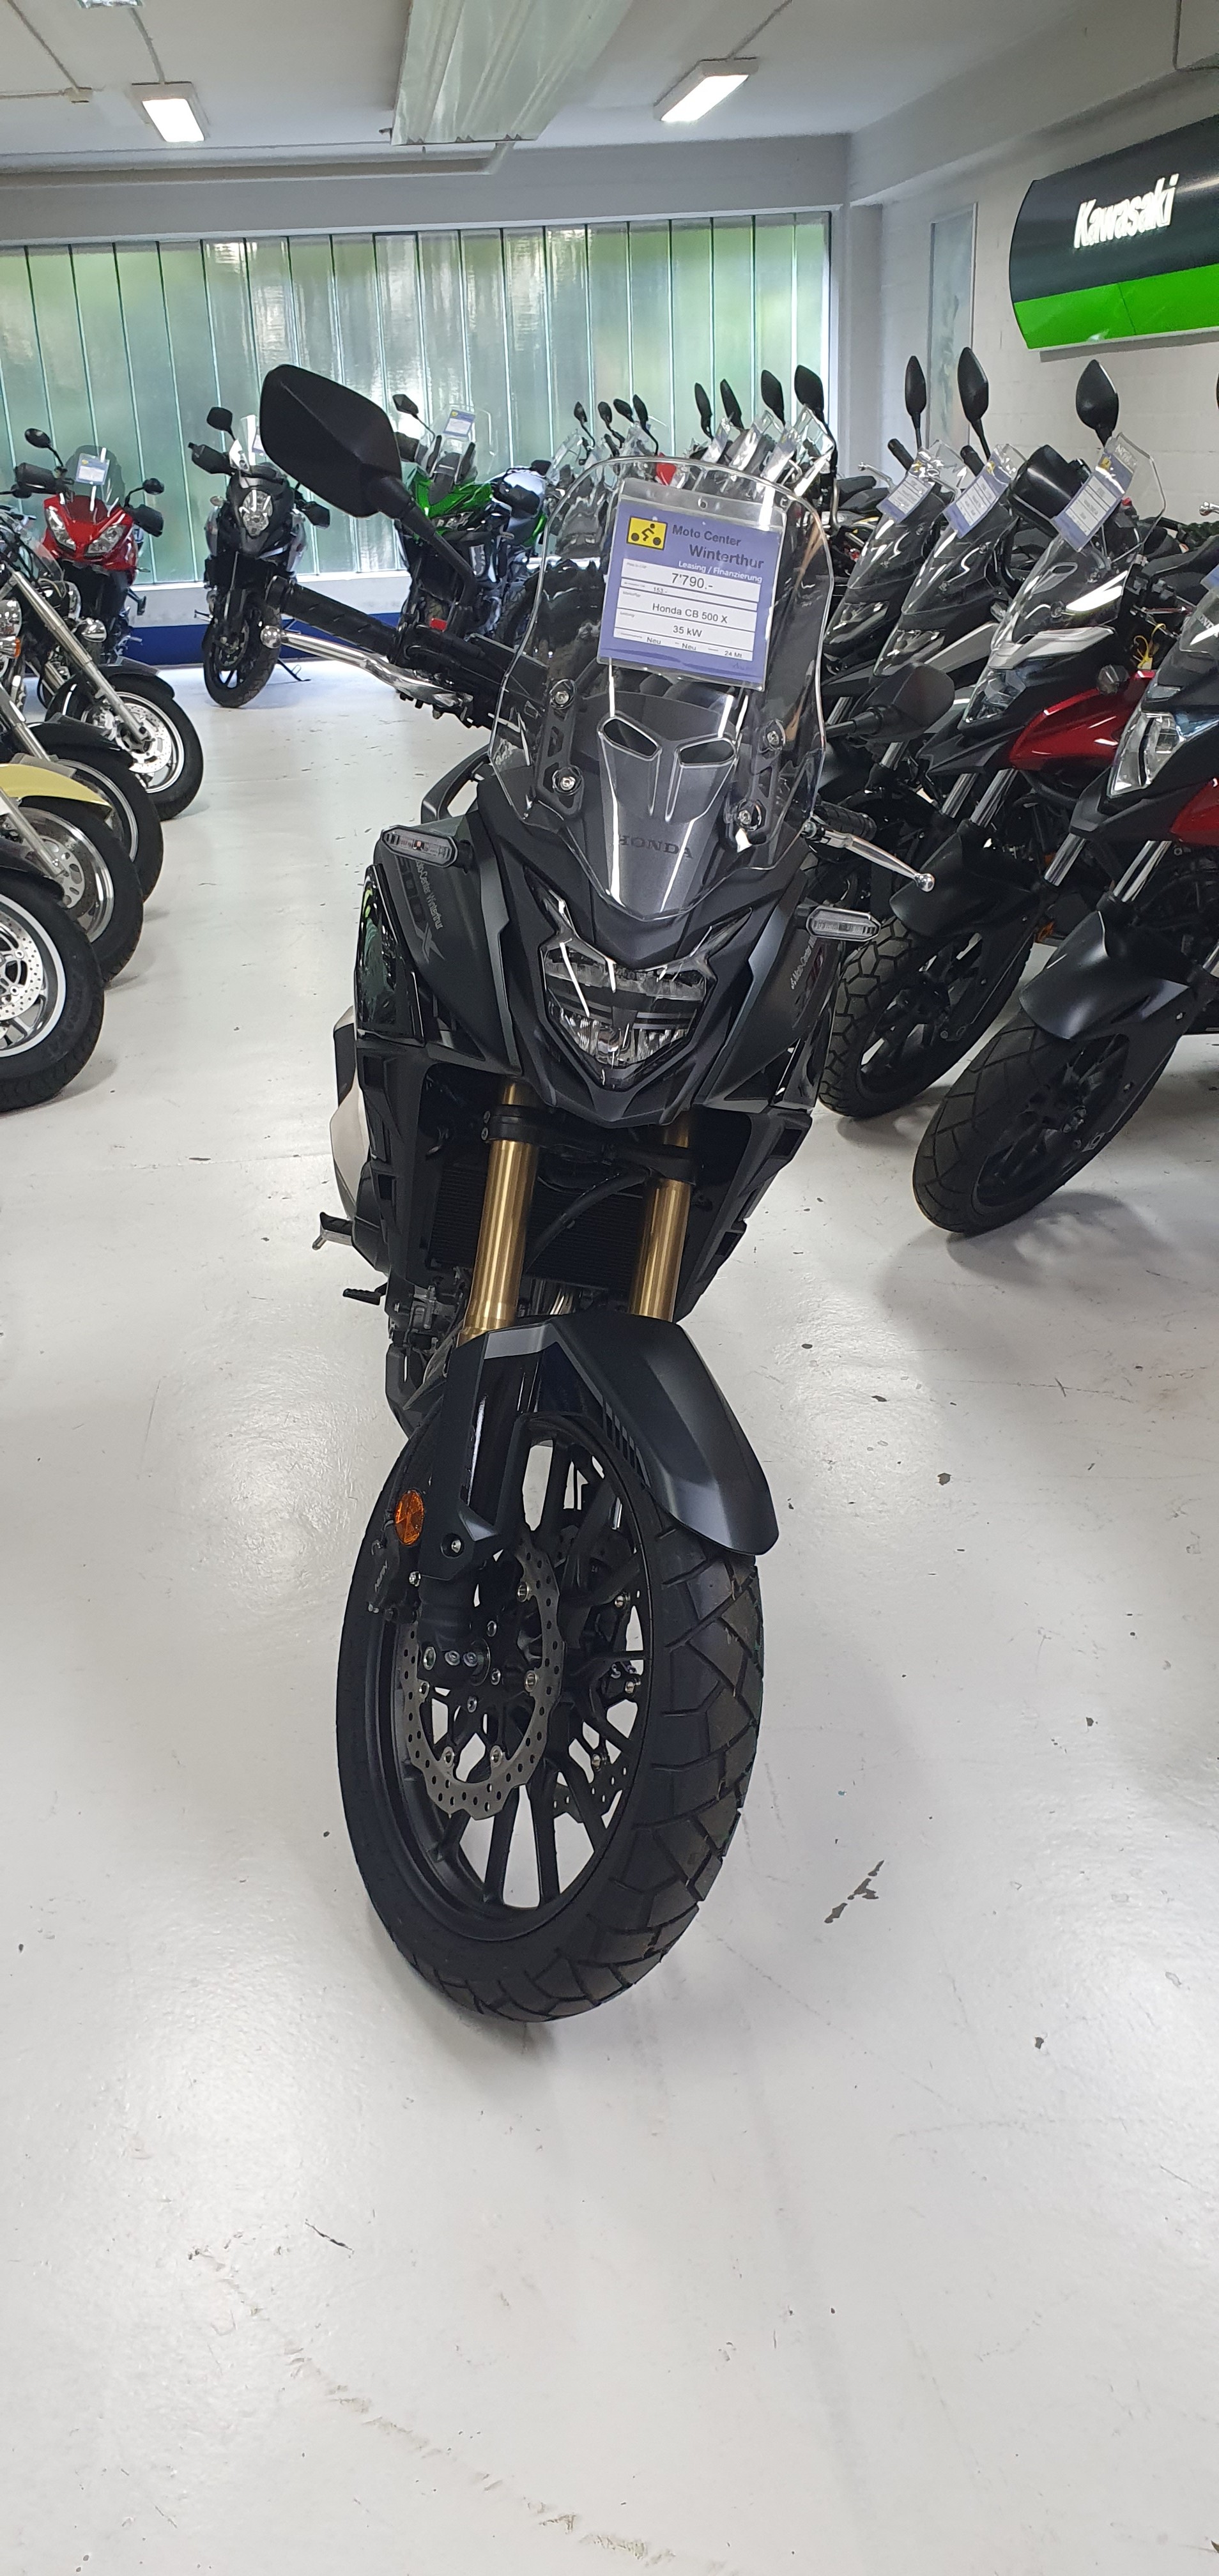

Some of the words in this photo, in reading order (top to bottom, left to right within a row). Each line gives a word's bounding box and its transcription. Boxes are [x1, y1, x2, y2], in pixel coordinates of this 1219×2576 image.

[1073, 173, 1179, 249] Kawasaki
[672, 525, 700, 539] Moto
[704, 531, 741, 546] Center
[689, 544, 764, 569] Winterthur
[671, 572, 714, 590] 7'790.-
[678, 560, 707, 573] Leasing
[713, 567, 763, 584] Finanzierung
[652, 602, 682, 615] Honda
[685, 609, 699, 618] CB
[702, 612, 719, 622] 500
[721, 615, 728, 624] X
[647, 636, 661, 645] Neu
[673, 625, 684, 634] 35
[687, 627, 702, 638] kW
[618, 834, 693, 859] HONDA
